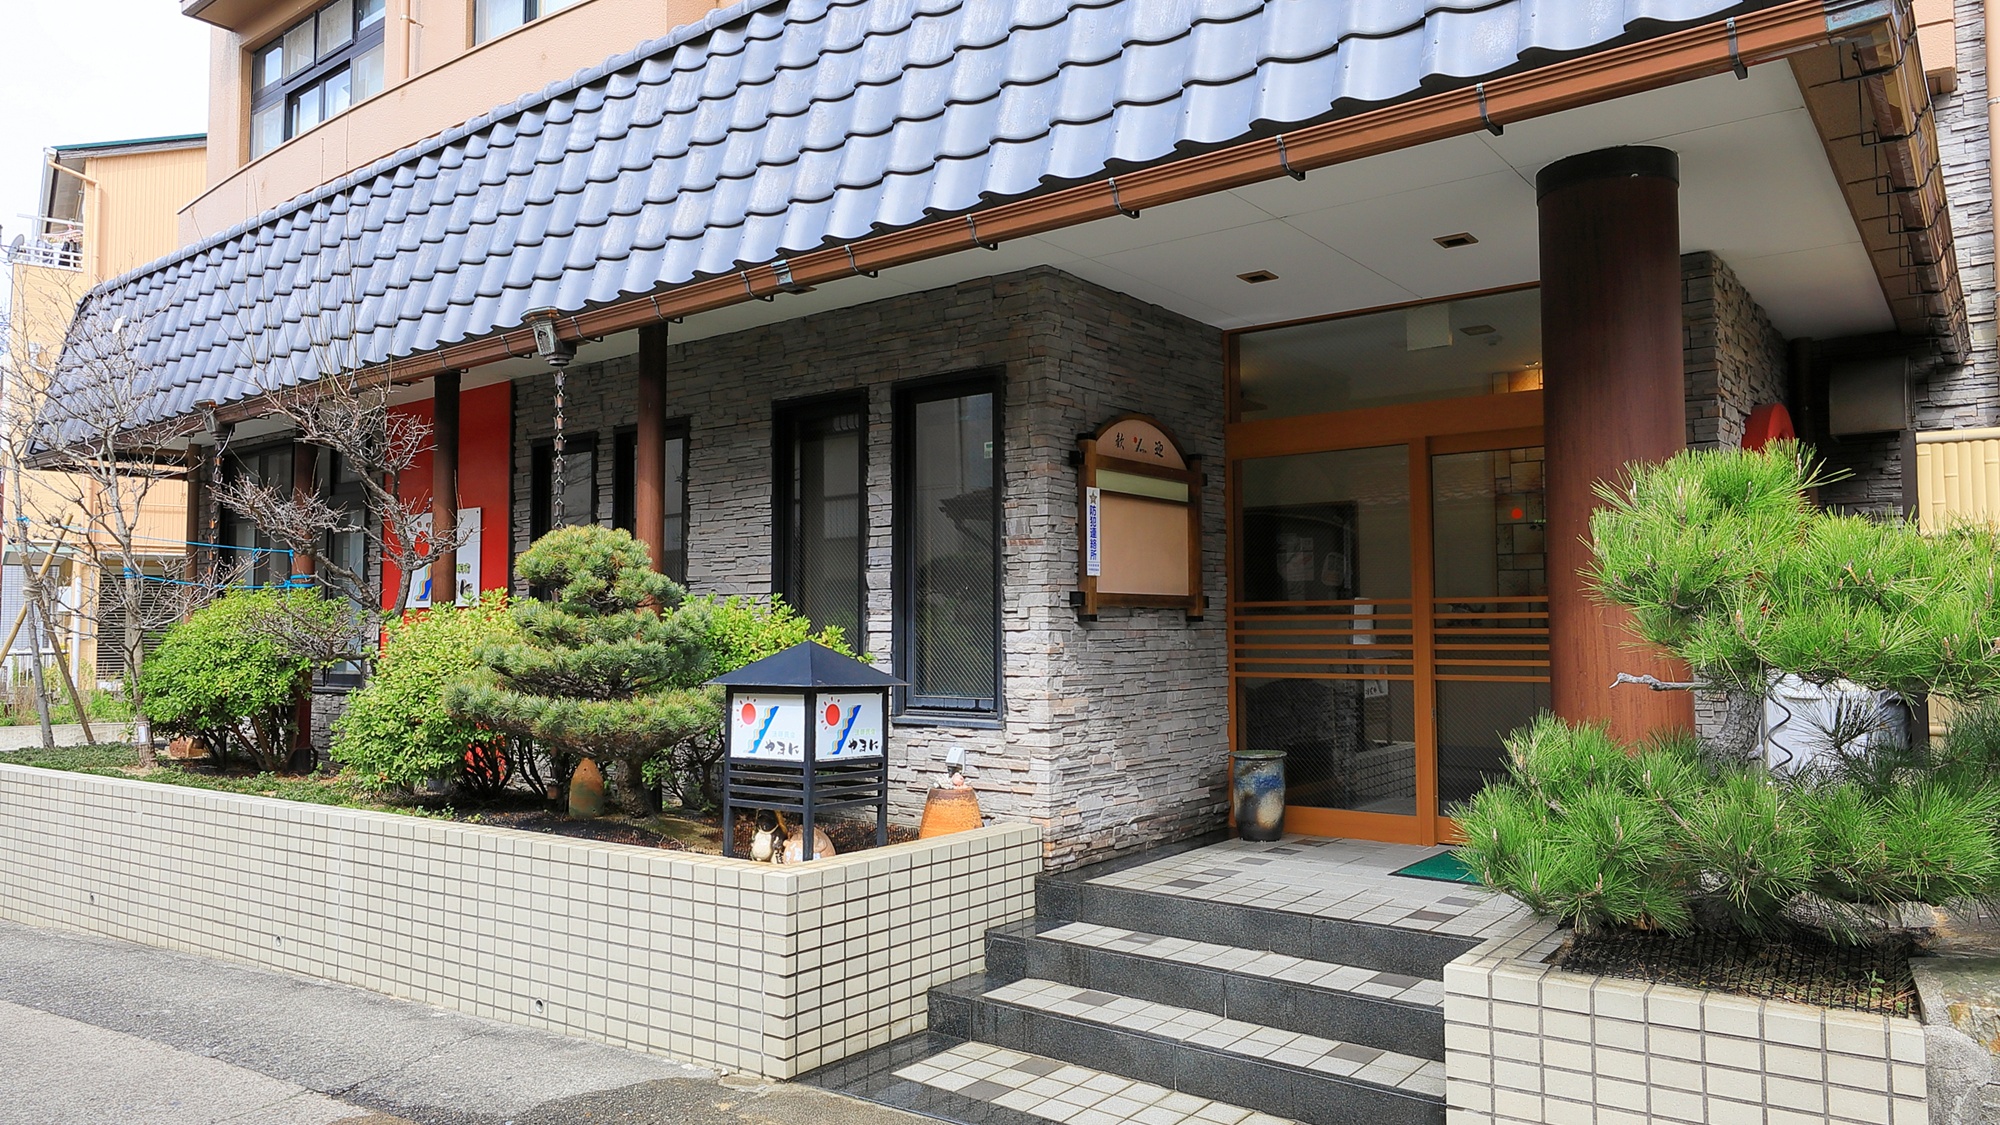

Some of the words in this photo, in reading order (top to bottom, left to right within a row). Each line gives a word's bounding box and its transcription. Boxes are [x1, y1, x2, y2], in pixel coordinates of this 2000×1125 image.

[1089, 504, 1098, 561] 防犯連絡所
[764, 739, 800, 756] やまに
[847, 738, 879, 754] やまに
